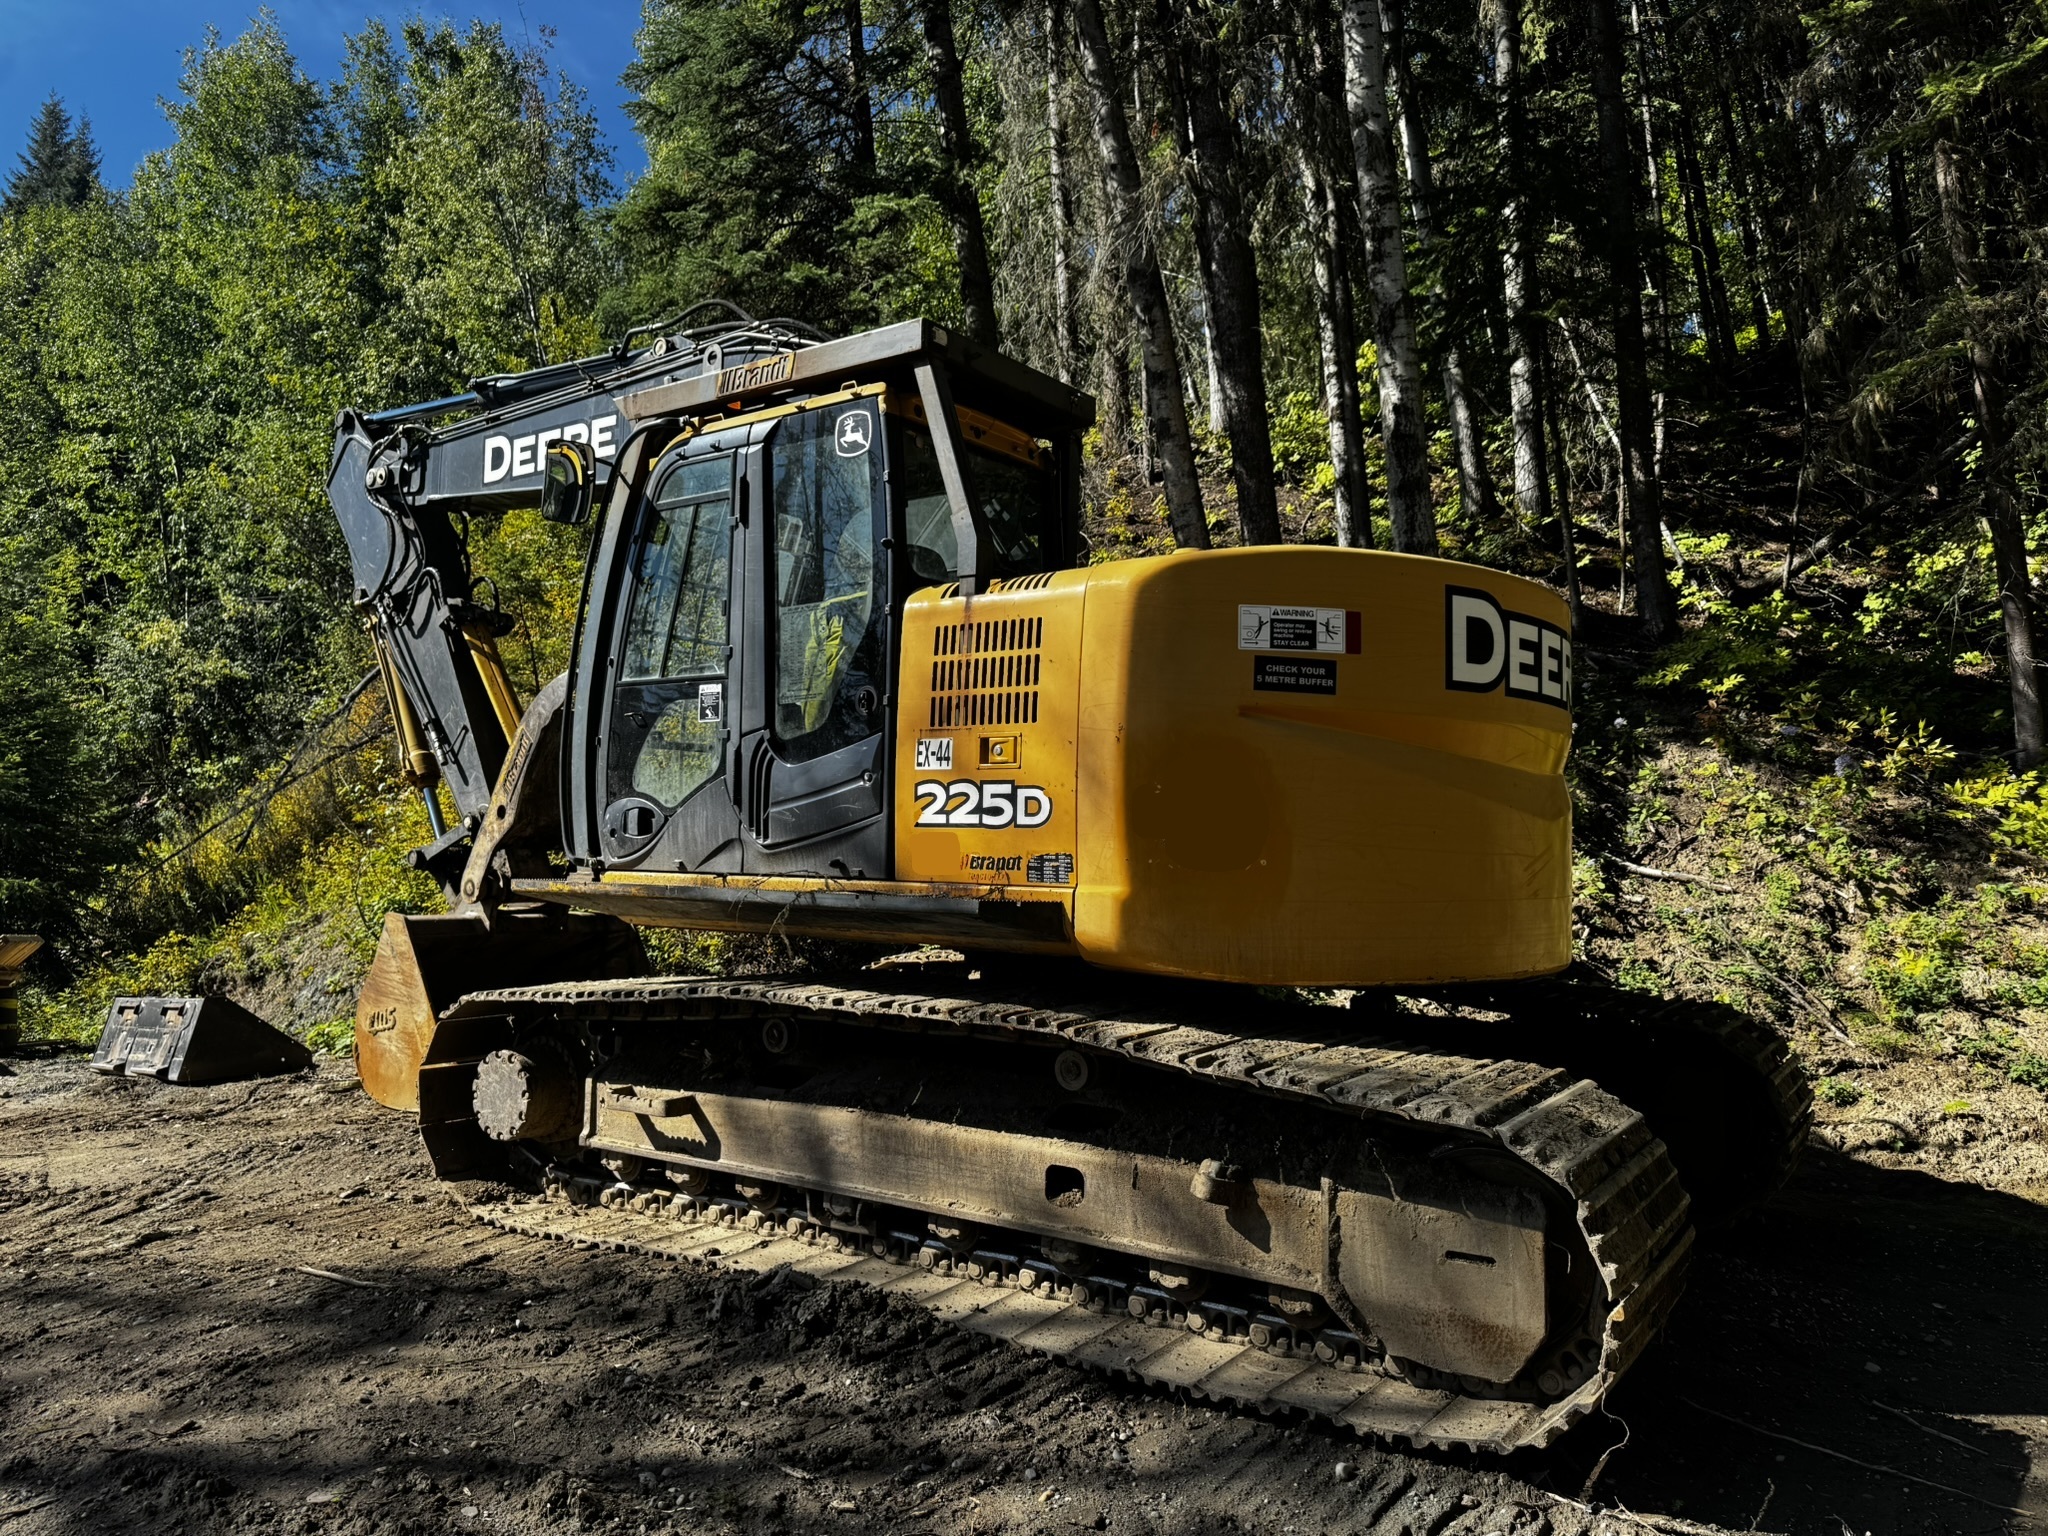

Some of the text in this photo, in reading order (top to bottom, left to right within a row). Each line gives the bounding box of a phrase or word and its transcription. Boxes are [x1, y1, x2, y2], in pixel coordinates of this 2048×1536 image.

[1279, 609, 1314, 618] WARNING
[1265, 664, 1326, 675] CHECK YOUR
[1256, 674, 1334, 687] 5 METRE BUFFER
[916, 740, 951, 768] EX-44
[915, 780, 1052, 828] 225D
